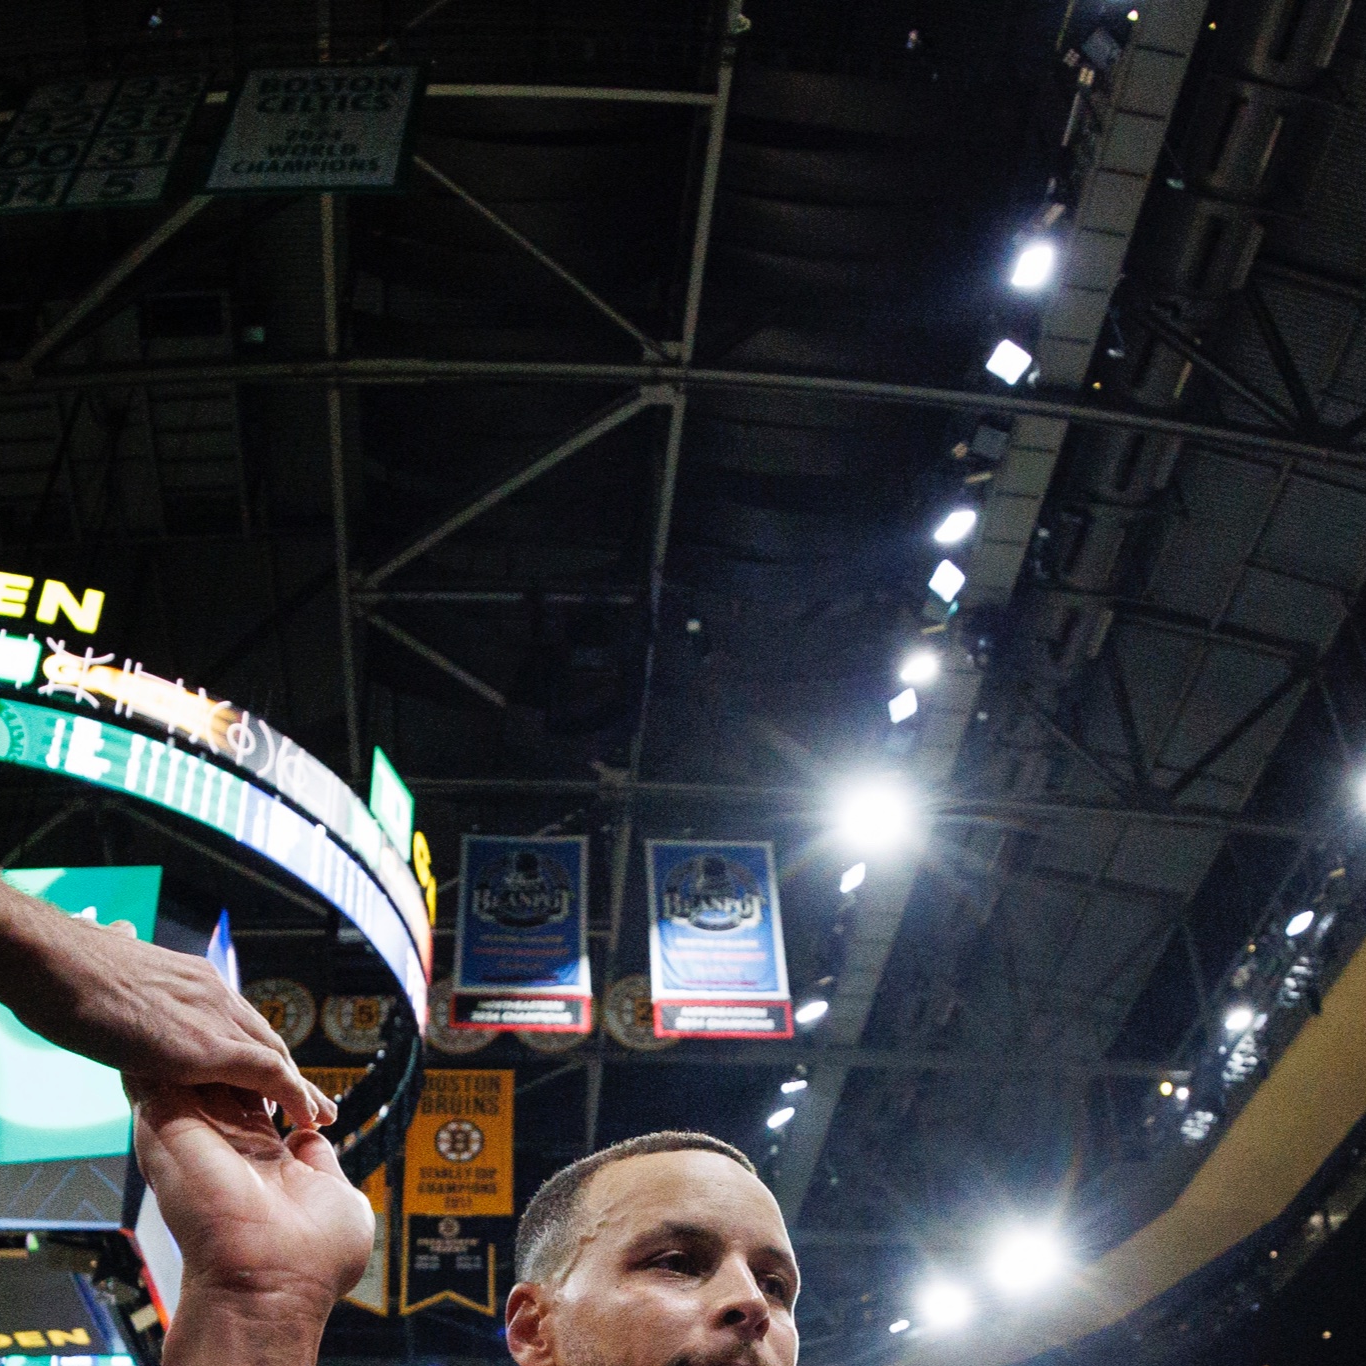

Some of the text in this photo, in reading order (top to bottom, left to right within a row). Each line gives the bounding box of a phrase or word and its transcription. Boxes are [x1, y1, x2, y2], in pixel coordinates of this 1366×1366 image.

[259, 74, 402, 94] BOSTON
[256, 95, 392, 114] CELTICS
[97, 138, 170, 163] 31
[267, 142, 359, 158] WORLD
[230, 156, 381, 174] CHAMPIONS
[97, 172, 136, 198] 5
[423, 1074, 501, 1093] BOSTON
